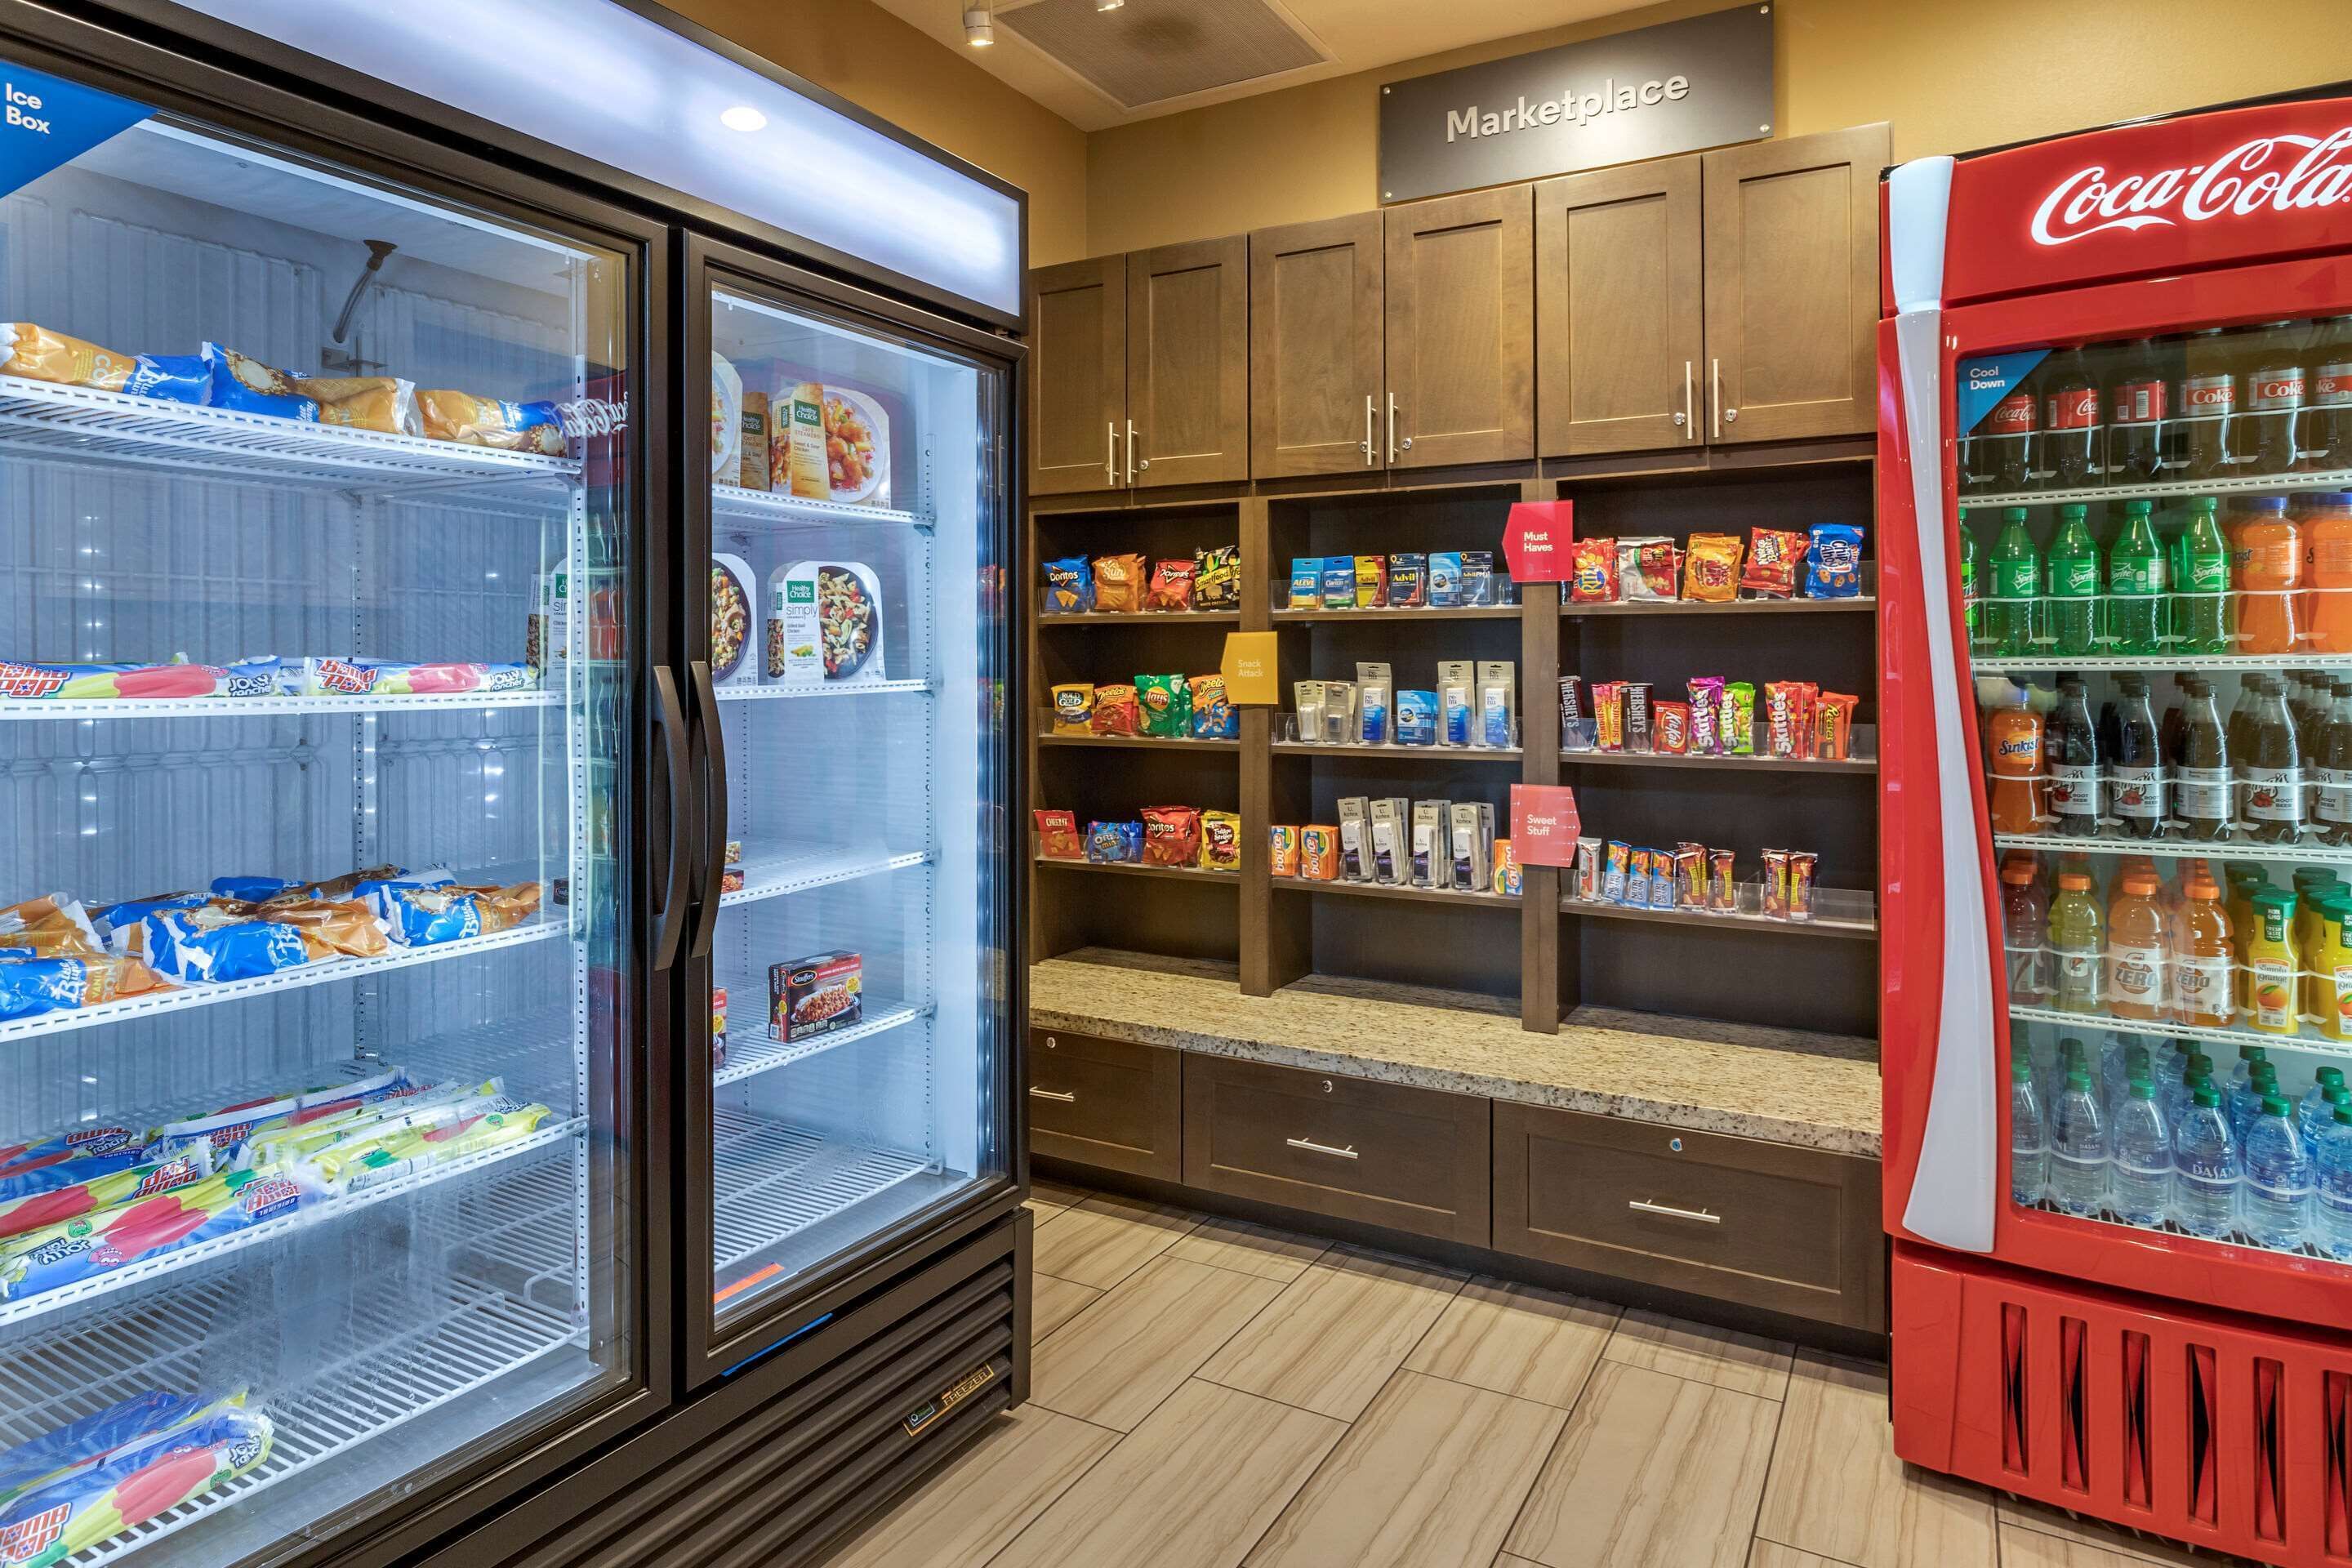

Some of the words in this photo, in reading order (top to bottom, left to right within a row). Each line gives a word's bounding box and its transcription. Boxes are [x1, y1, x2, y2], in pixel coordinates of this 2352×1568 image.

[6, 82, 42, 109] Ice
[1446, 74, 1690, 144] Marketplace
[6, 105, 51, 135] Box
[2030, 127, 2352, 245] Coca-Cola
[1970, 366, 1999, 378] Cool
[1970, 378, 2005, 390] Down
[2264, 381, 2305, 398] Coke
[2192, 389, 2233, 404] Coke
[1523, 532, 1548, 541] Must
[1523, 543, 1553, 552] Haves
[1049, 571, 1079, 581] Doritos
[1392, 573, 1415, 581] Advil
[2072, 571, 2097, 581] Sprite
[2194, 566, 2225, 577] Sprite
[1196, 571, 1230, 588] Smartfood
[786, 604, 818, 619] simply
[1238, 659, 1262, 667] Snack
[1238, 668, 1263, 677] Attack
[1199, 677, 1224, 697] Cheeto
[1059, 697, 1082, 706] GOLD
[1146, 692, 1169, 703] Lay's
[1561, 681, 1580, 728] HERSHEY'S
[1629, 686, 1647, 733] HERSHEY'S
[1690, 689, 1714, 747] Skittles
[1719, 693, 1739, 746] Skittles
[1772, 692, 1792, 753] Skittles
[1999, 737, 2039, 755] Sunkist
[1526, 814, 1557, 825] Sweet
[1147, 822, 1174, 833] Doritos
[1526, 826, 1550, 836] Stuff
[1272, 833, 1285, 871] bounce
[1307, 835, 1321, 875] bounce
[943, 1371, 987, 1405] FREEZER
